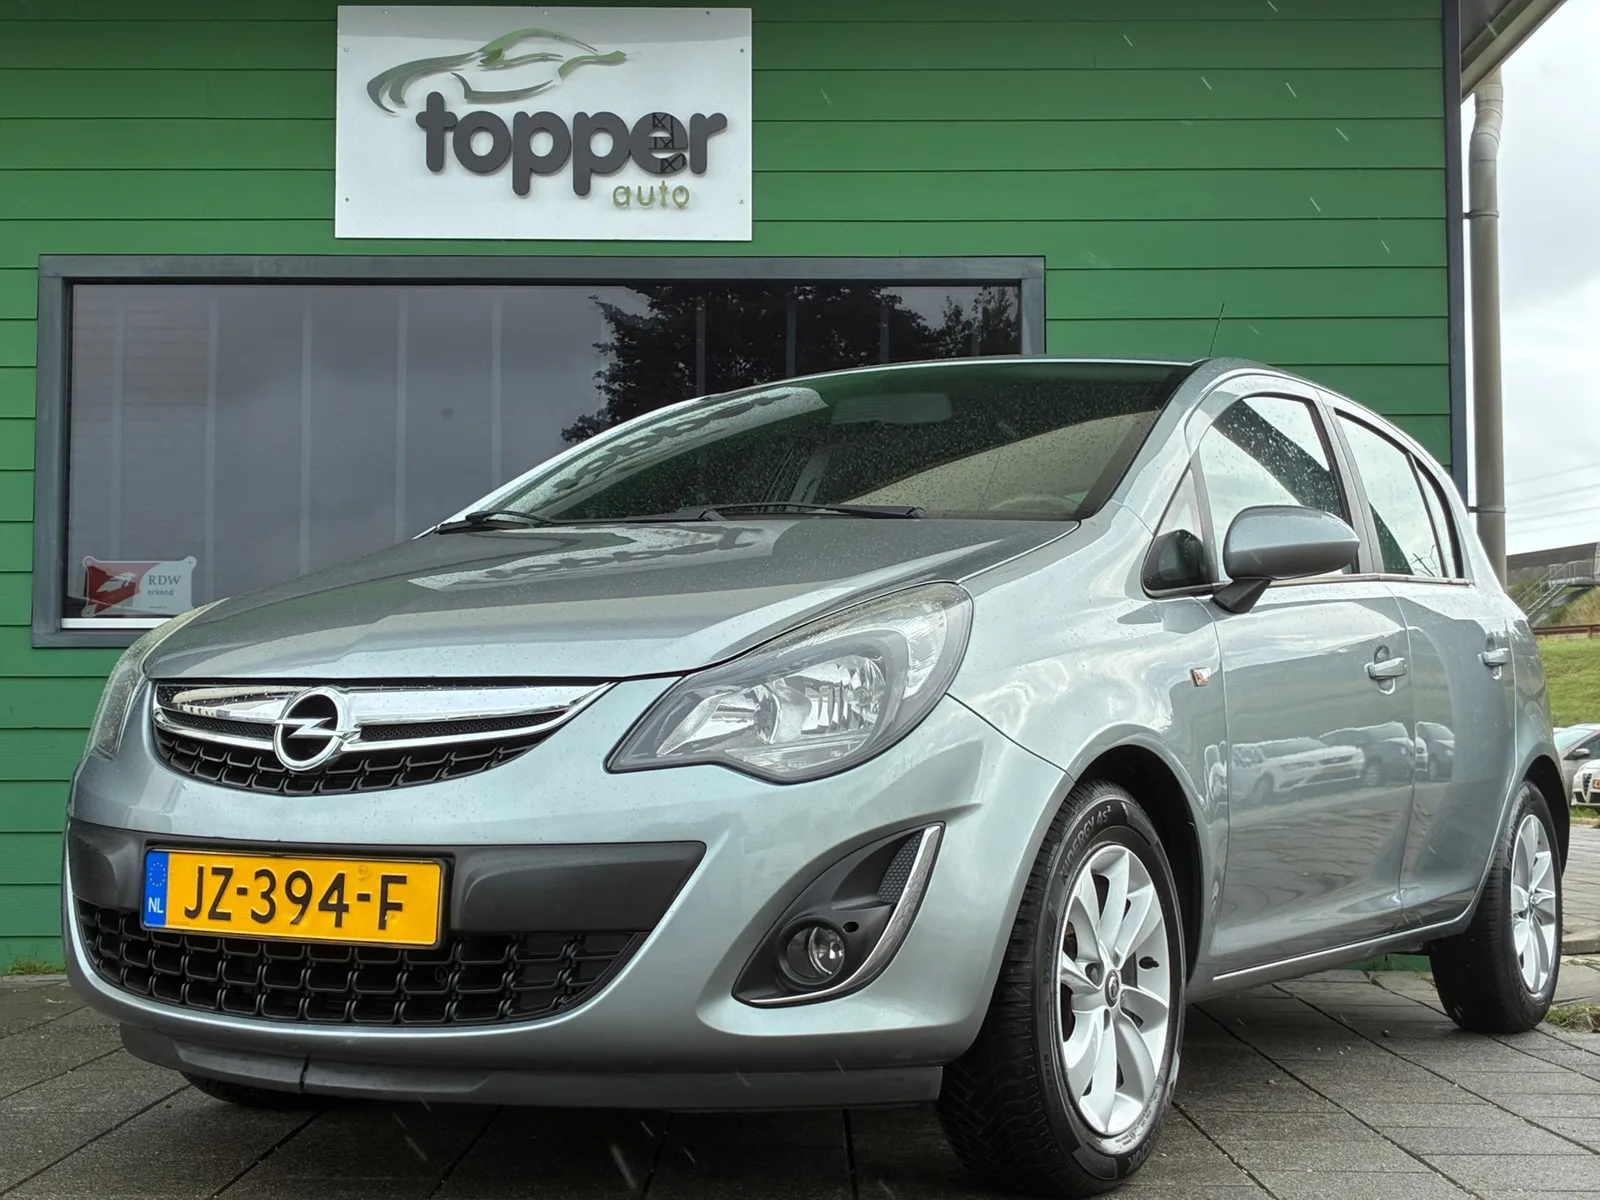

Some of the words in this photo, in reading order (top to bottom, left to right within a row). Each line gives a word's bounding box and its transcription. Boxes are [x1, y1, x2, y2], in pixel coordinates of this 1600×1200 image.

[416, 91, 728, 197] topper
[613, 181, 690, 209] auto
[147, 588, 174, 596] erkend
[148, 575, 181, 586] RDW
[148, 896, 164, 914] NL
[184, 865, 408, 930] JZ-394-F
